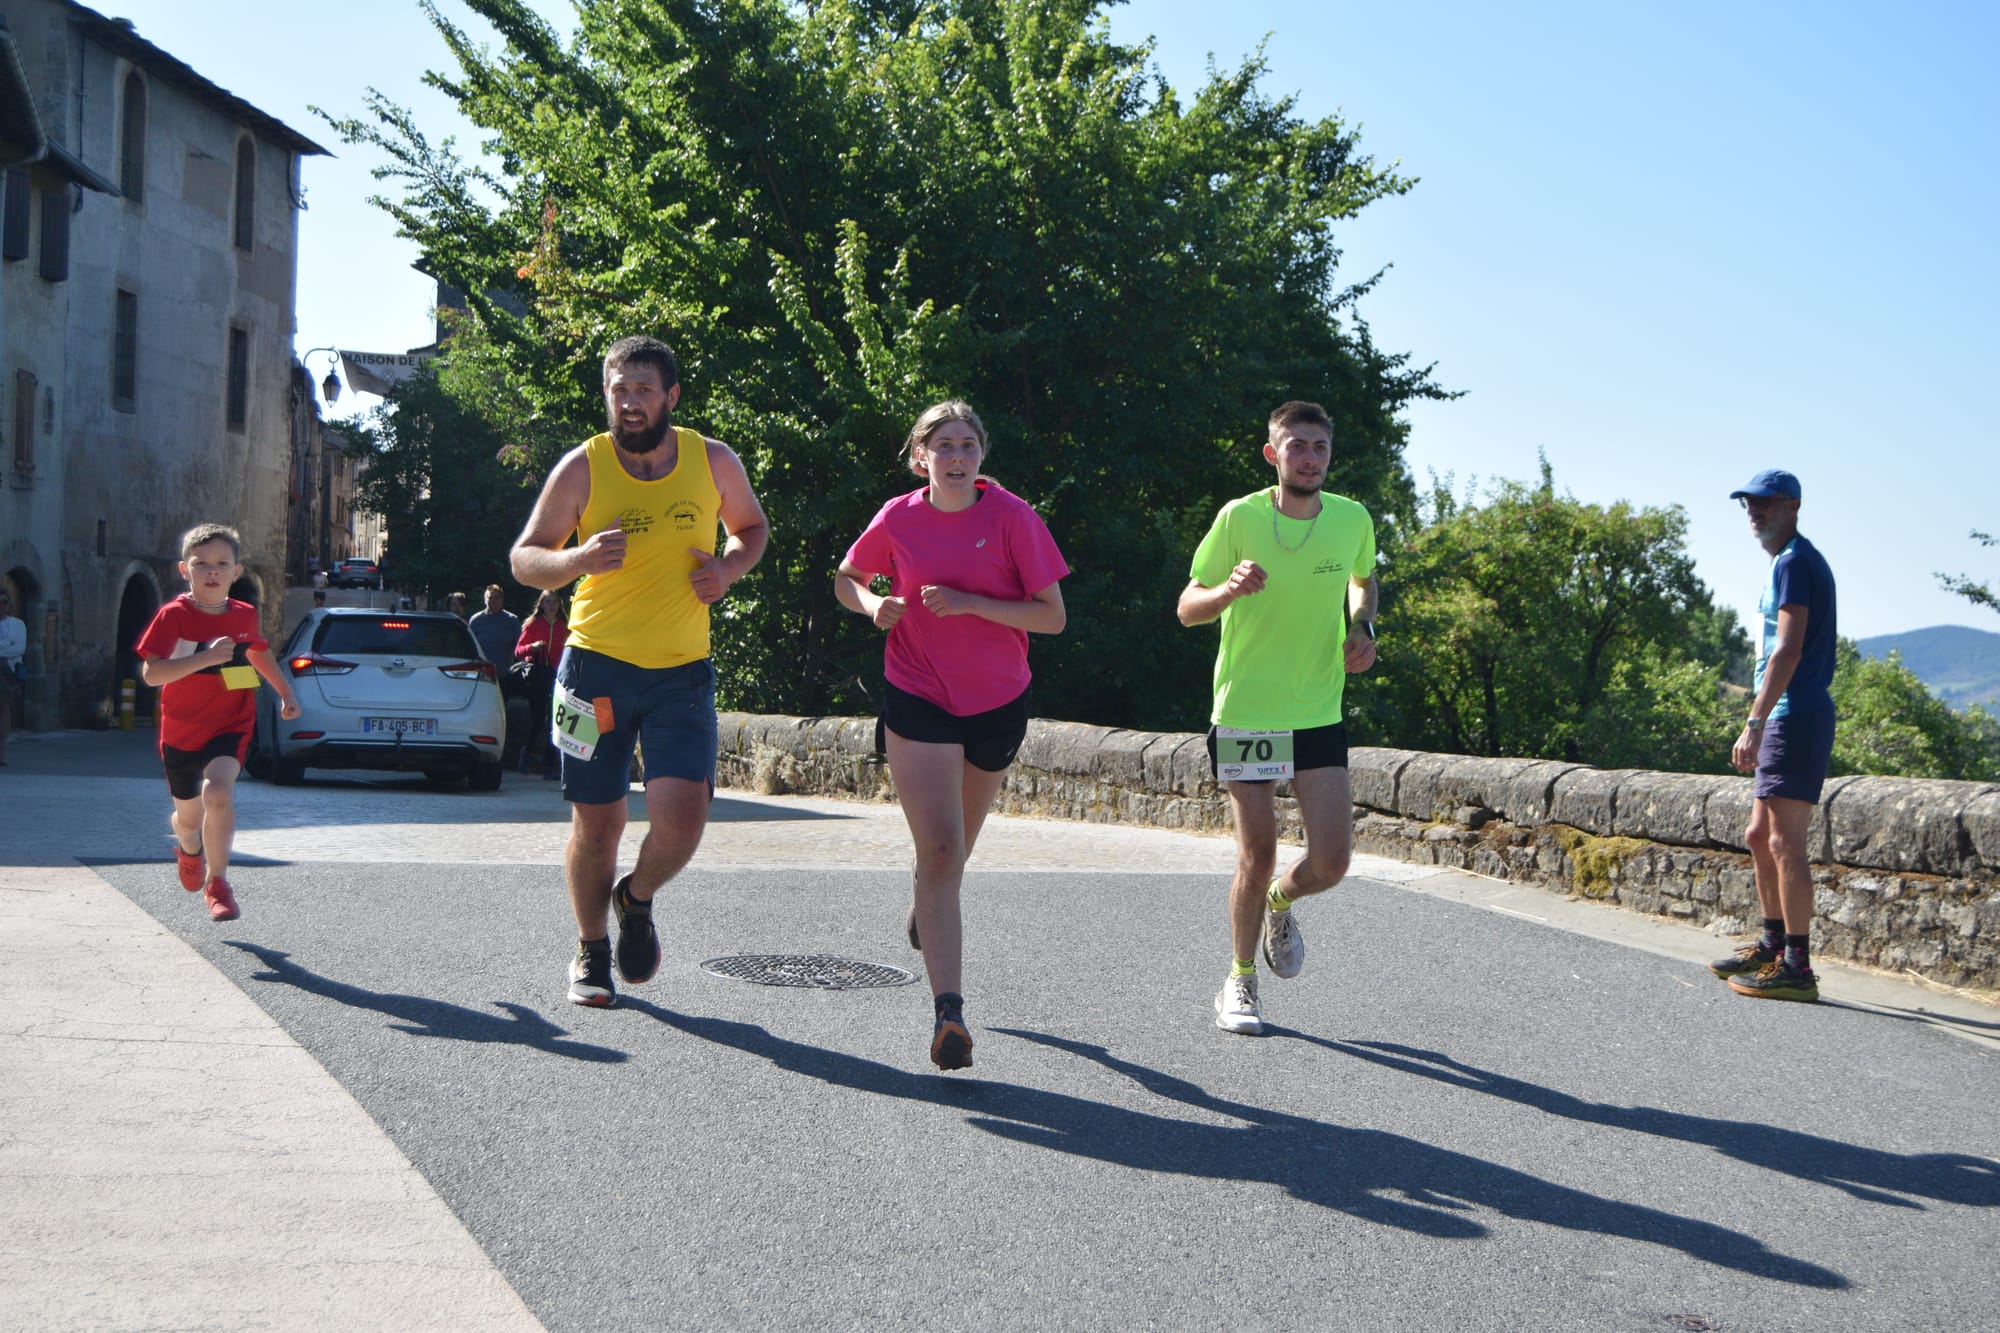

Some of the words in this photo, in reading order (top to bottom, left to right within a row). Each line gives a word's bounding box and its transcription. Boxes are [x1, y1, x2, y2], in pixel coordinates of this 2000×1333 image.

[342, 353, 394, 365] MAISON
[399, 356, 415, 366] DE
[371, 719, 425, 733] FA-405-BC
[556, 703, 580, 735] 81
[1236, 739, 1273, 762] 70
